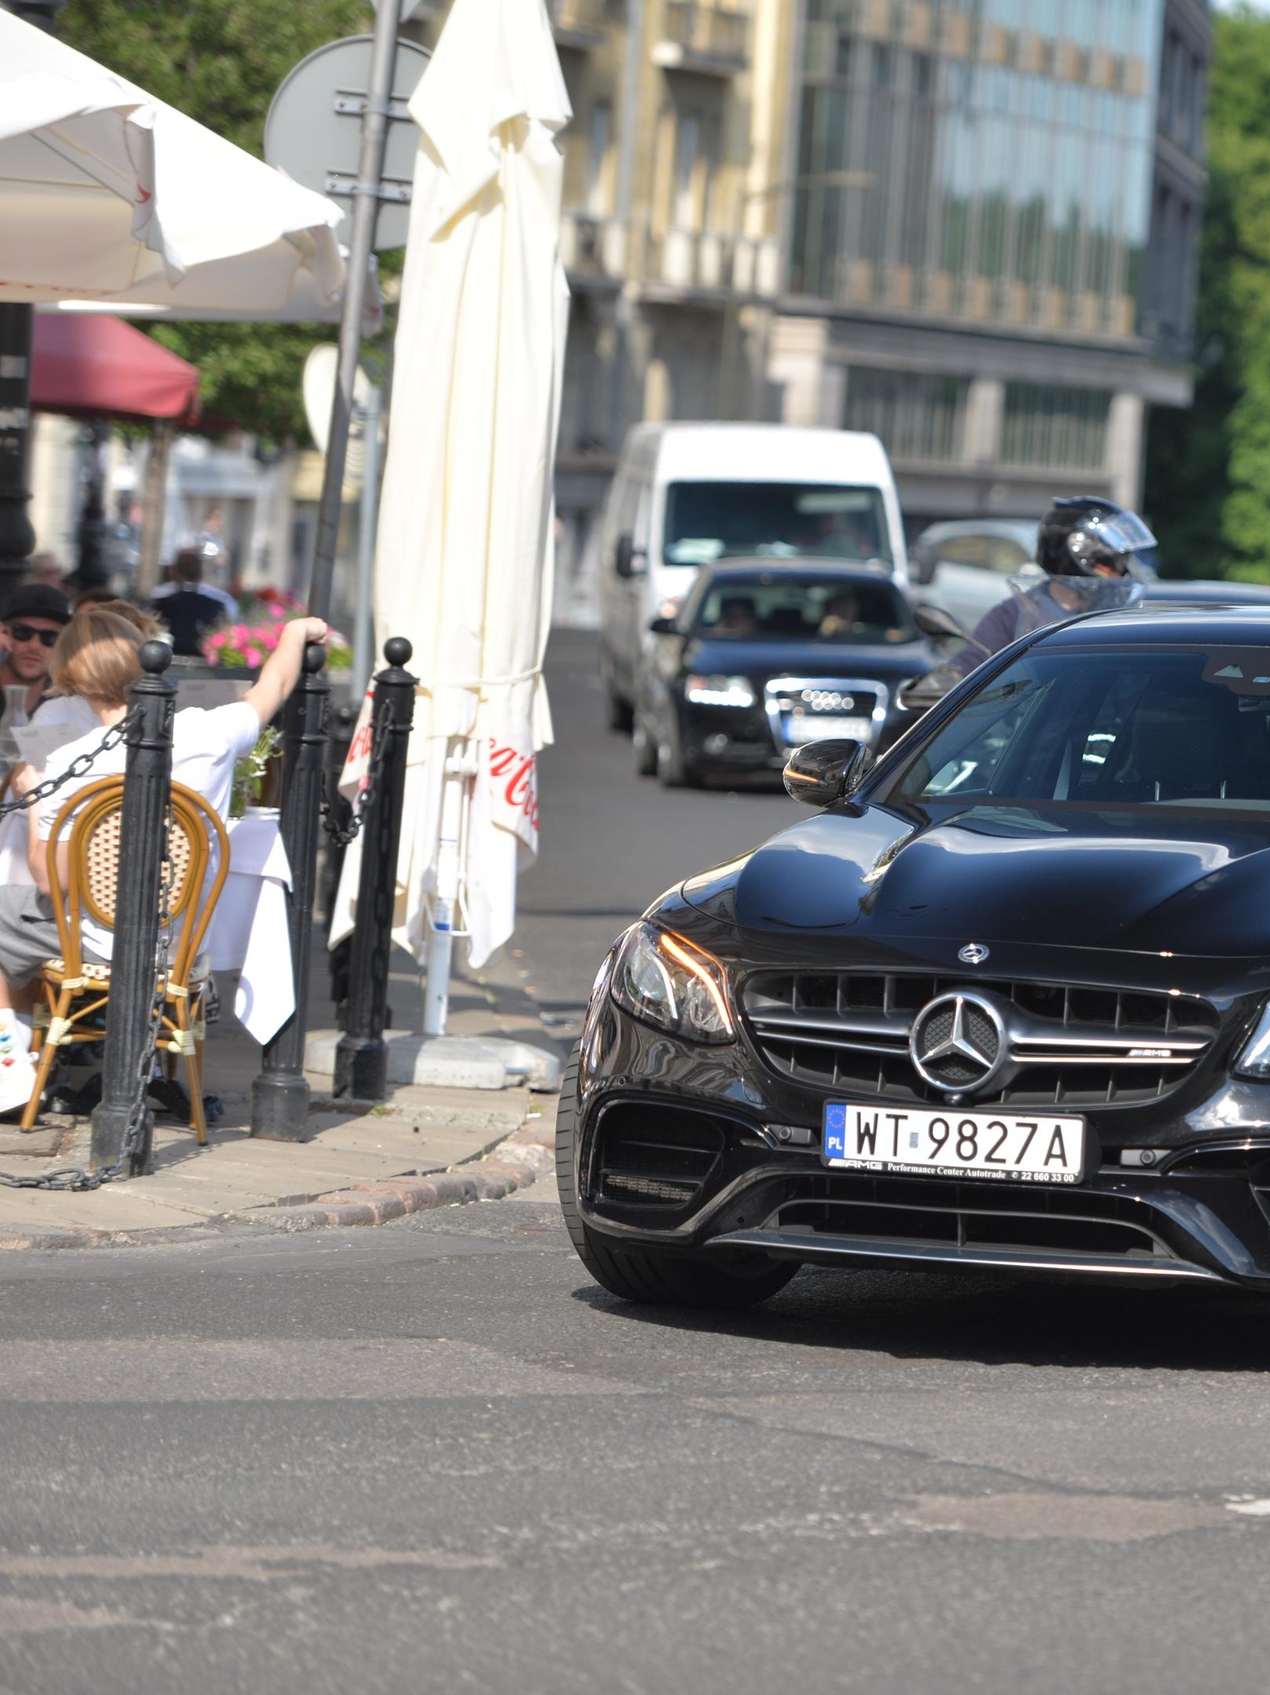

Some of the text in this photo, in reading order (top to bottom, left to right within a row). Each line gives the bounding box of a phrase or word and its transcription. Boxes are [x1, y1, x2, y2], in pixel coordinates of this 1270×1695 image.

[828, 1137, 843, 1150] PL
[856, 1111, 1068, 1168] WT 9827A
[846, 1160, 1075, 1183] AMG Performance Center Autotrade 22 660 33 00
